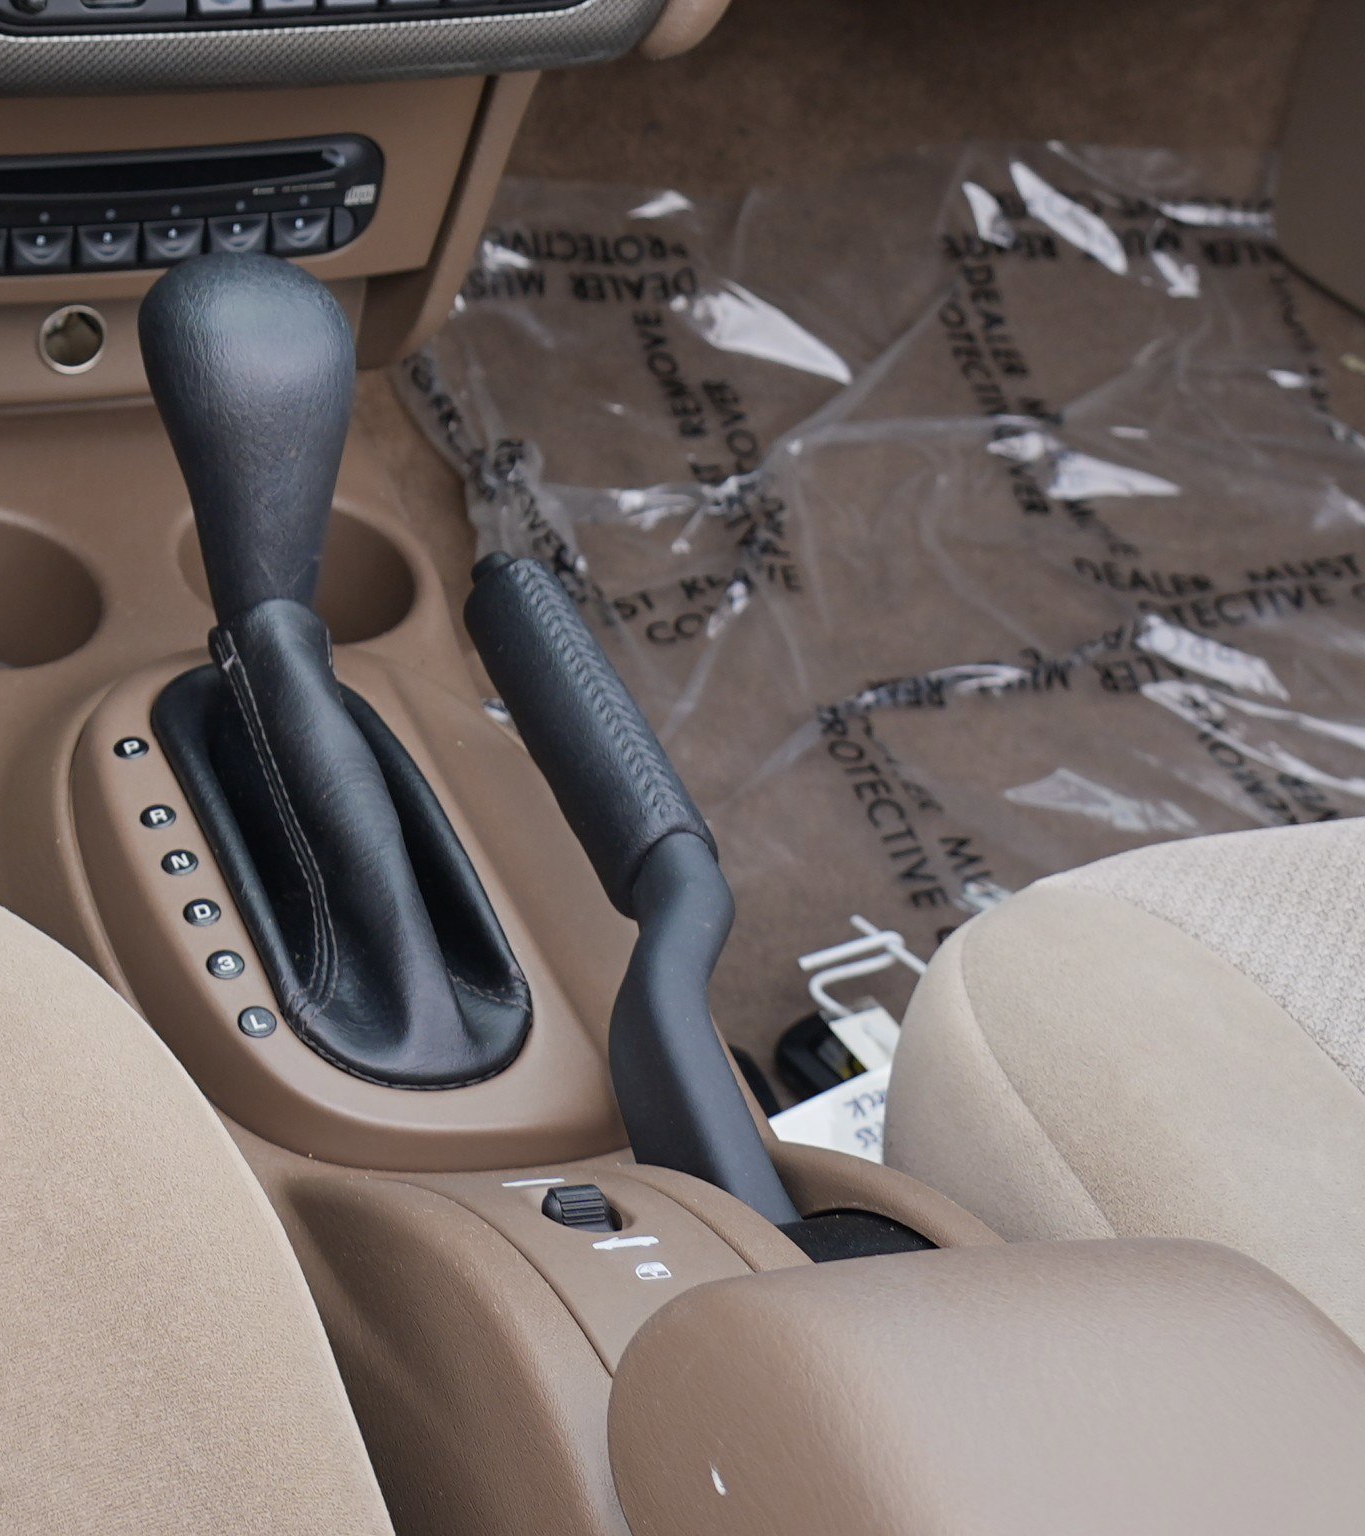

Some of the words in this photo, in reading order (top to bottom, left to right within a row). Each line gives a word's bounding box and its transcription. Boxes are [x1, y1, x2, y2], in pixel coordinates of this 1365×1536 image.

[124, 741, 139, 754] P
[149, 809, 168, 823] R
[170, 854, 189, 869] N
[193, 904, 211, 920] D
[217, 955, 235, 972] 3
[249, 1014, 267, 1031] L
